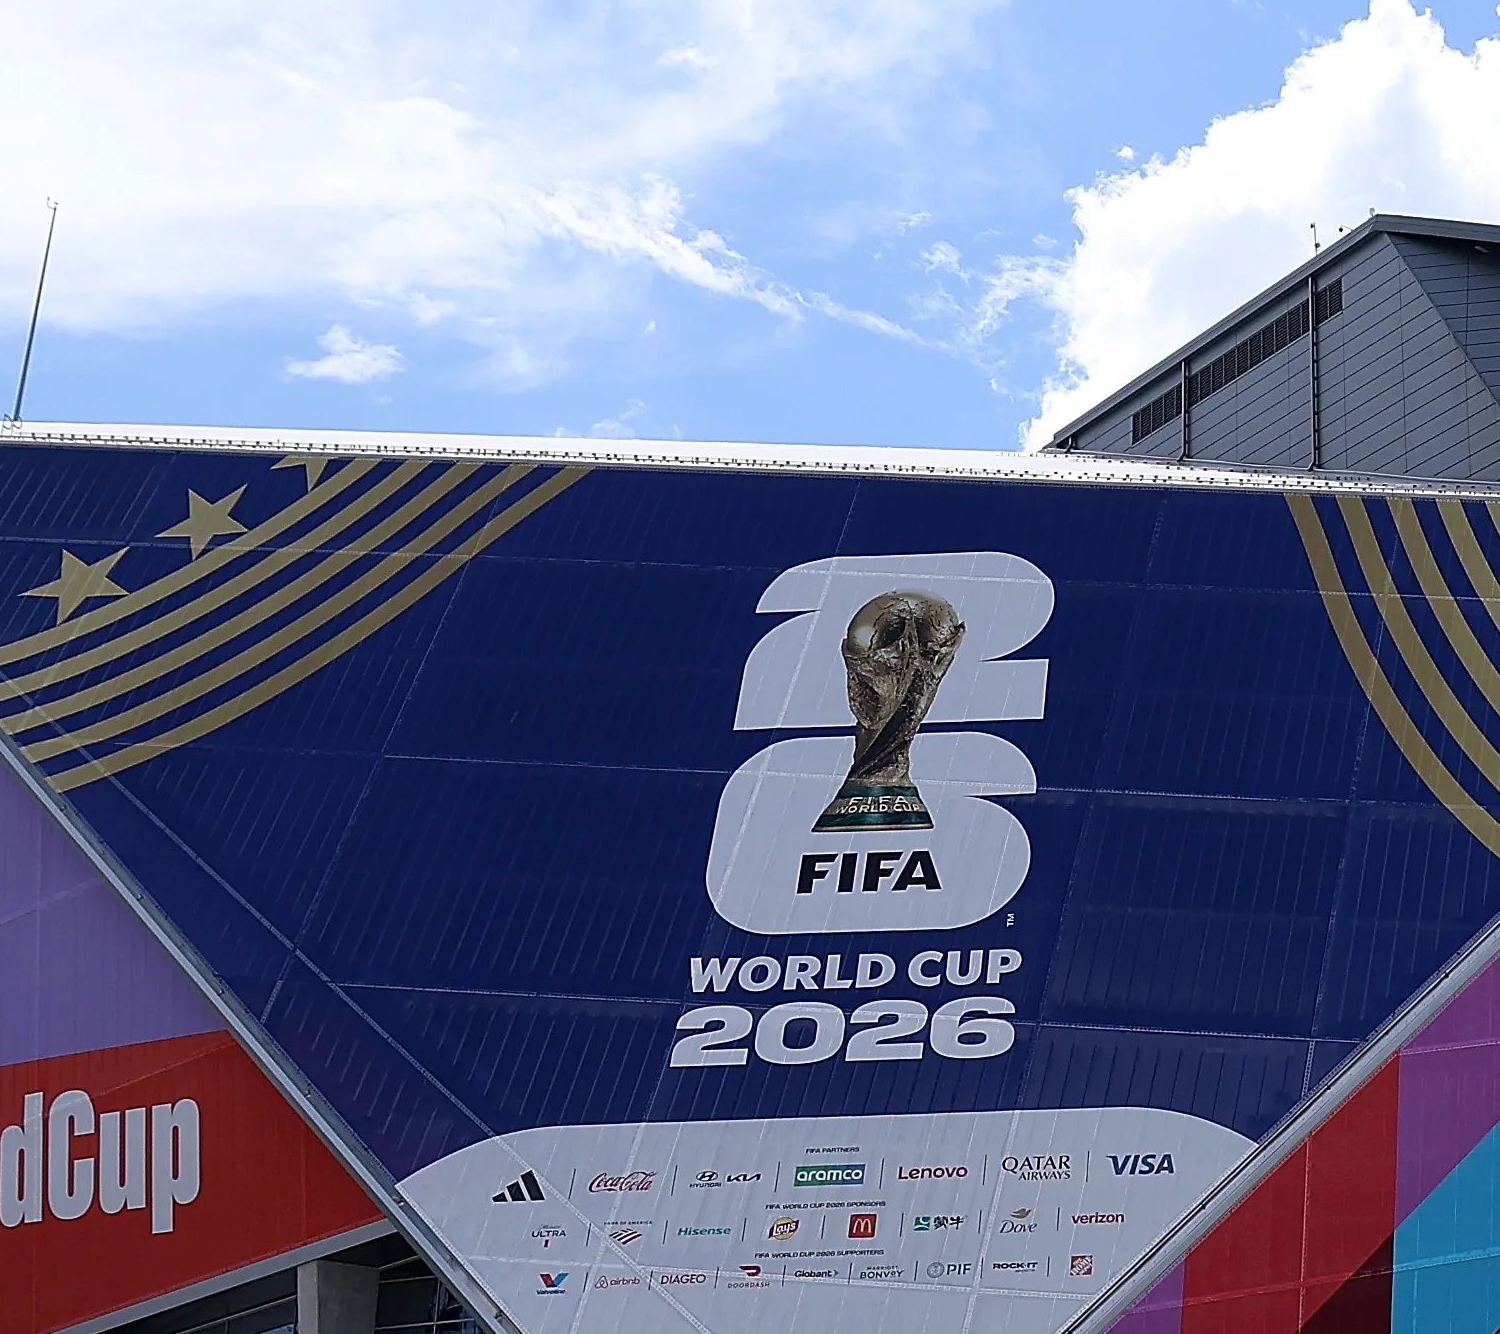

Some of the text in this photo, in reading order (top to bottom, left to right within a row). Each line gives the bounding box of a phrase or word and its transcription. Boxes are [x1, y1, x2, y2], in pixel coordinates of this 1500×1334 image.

[848, 795, 909, 806] FIFA
[834, 803, 921, 815] WORLD CUP
[796, 850, 943, 895] FIFA
[689, 949, 1023, 993] WORLD CUP
[669, 996, 1017, 1067] 2026
[1001, 1155, 1071, 1174] QATAR
[1105, 1153, 1176, 1176] VISA
[795, 1167, 864, 1183] aramco
[898, 1166, 968, 1180] Lenovo
[1018, 1170, 1071, 1181] AIRWAYS
[1071, 1212, 1125, 1224] verizon
[677, 1226, 731, 1236] Hisense
[999, 1220, 1038, 1234] Dove
[531, 1229, 567, 1238] ULTRA
[794, 1270, 832, 1278] Globant
[946, 1264, 971, 1276] PIF
[609, 1277, 640, 1286] airbnb
[660, 1274, 706, 1285] DIAGEO
